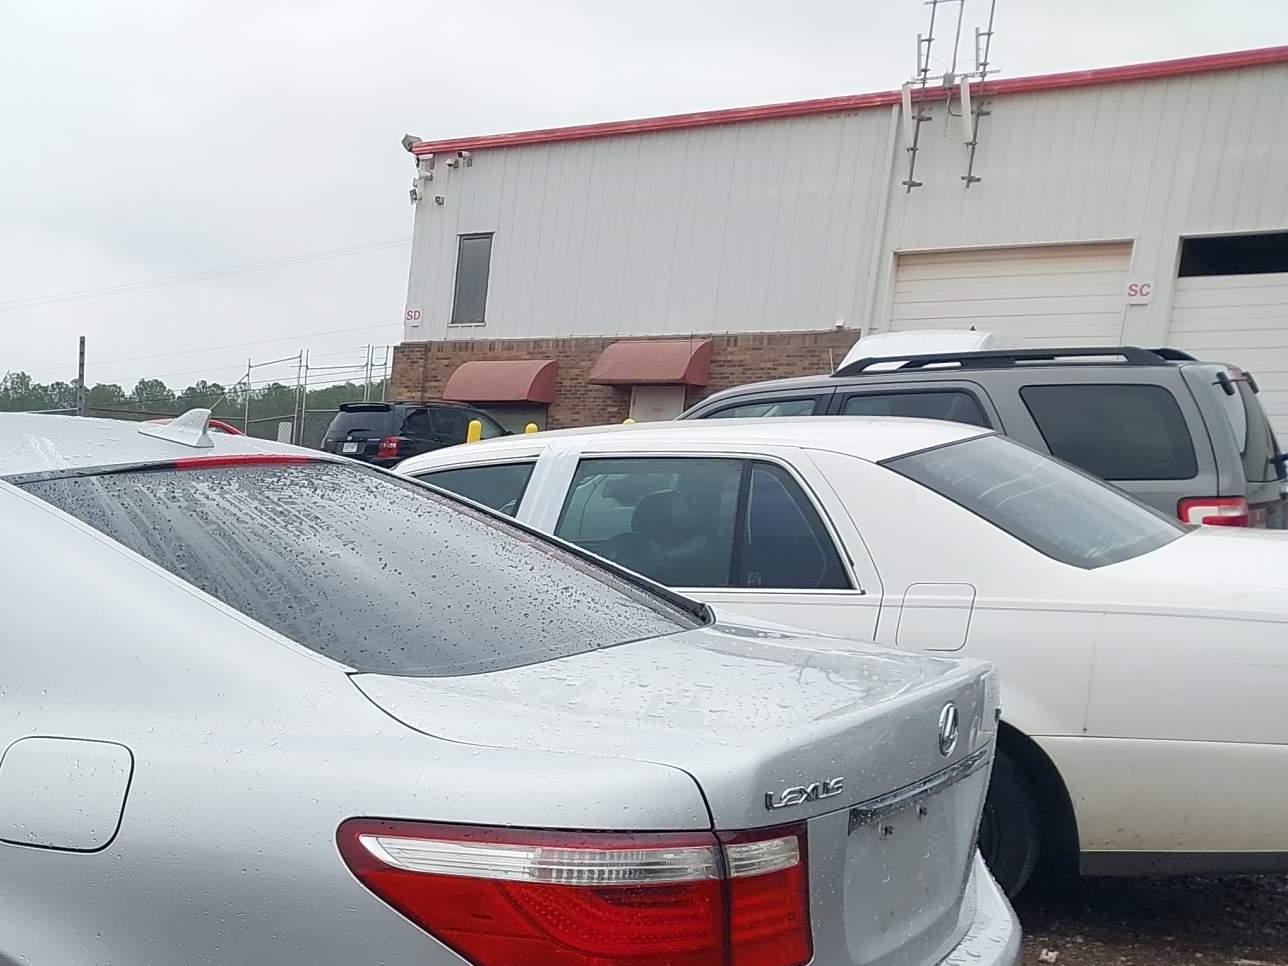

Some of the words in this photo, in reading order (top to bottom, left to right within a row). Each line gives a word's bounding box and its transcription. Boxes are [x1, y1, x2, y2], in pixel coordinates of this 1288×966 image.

[1127, 283, 1151, 297] SC
[406, 310, 421, 321] SD
[765, 776, 844, 811] LEXUS
